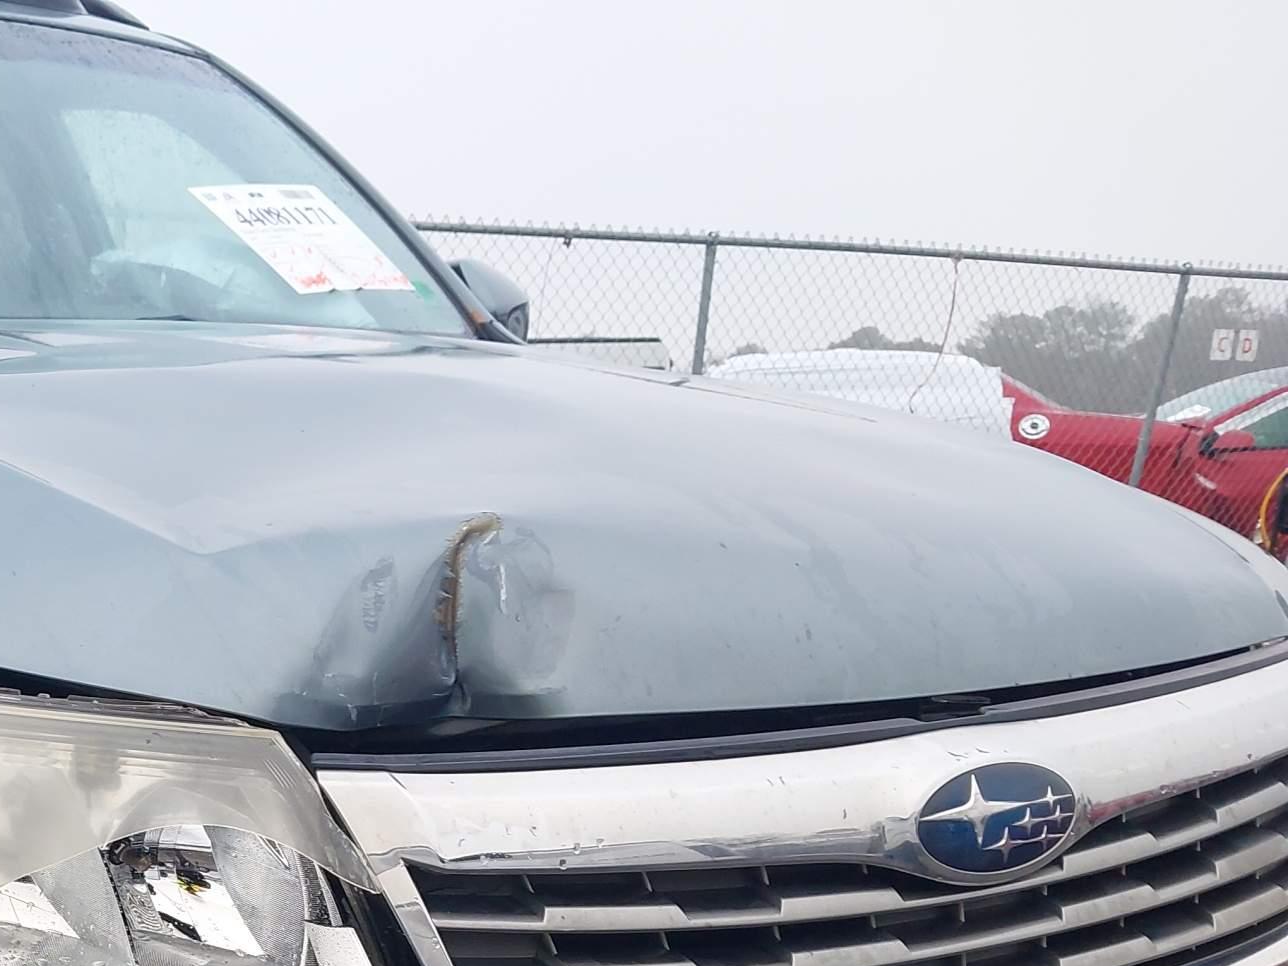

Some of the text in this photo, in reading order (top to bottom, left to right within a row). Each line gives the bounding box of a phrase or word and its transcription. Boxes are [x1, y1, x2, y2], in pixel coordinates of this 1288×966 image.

[235, 206, 337, 227] 44081171
[1217, 336, 1230, 353] C
[1241, 337, 1253, 354] D
